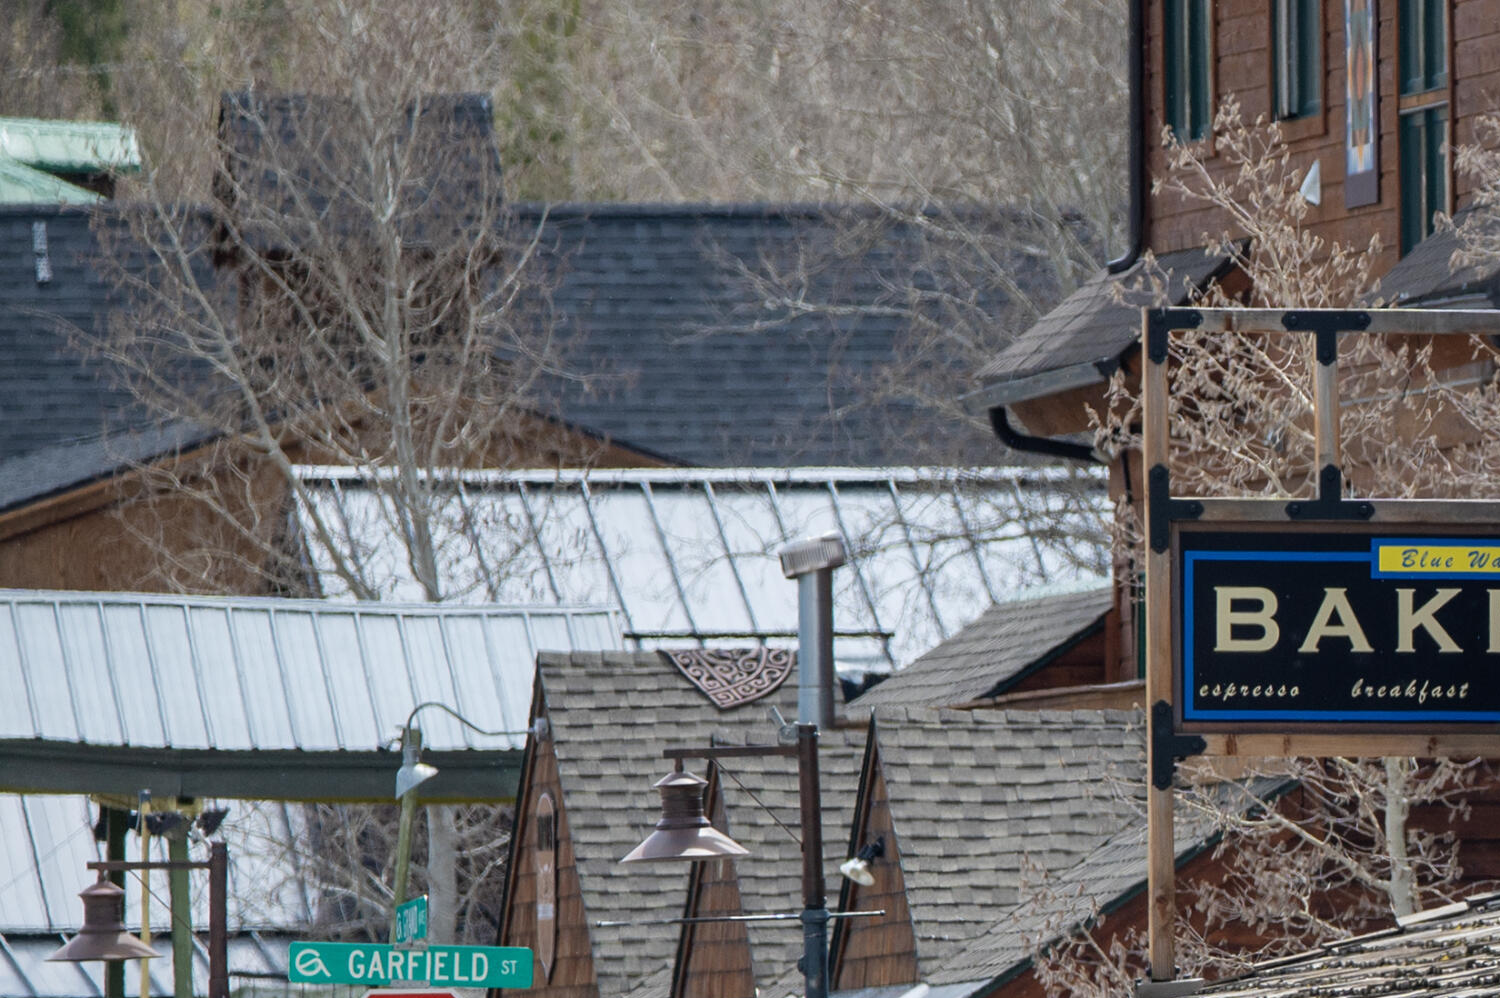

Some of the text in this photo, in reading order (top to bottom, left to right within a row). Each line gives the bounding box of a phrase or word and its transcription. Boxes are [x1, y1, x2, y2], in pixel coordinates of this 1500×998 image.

[1401, 549, 1455, 569] Blue
[1199, 682, 1301, 701] espresso
[1351, 678, 1470, 704] breakfast
[348, 949, 518, 982] GARFIELD ST
